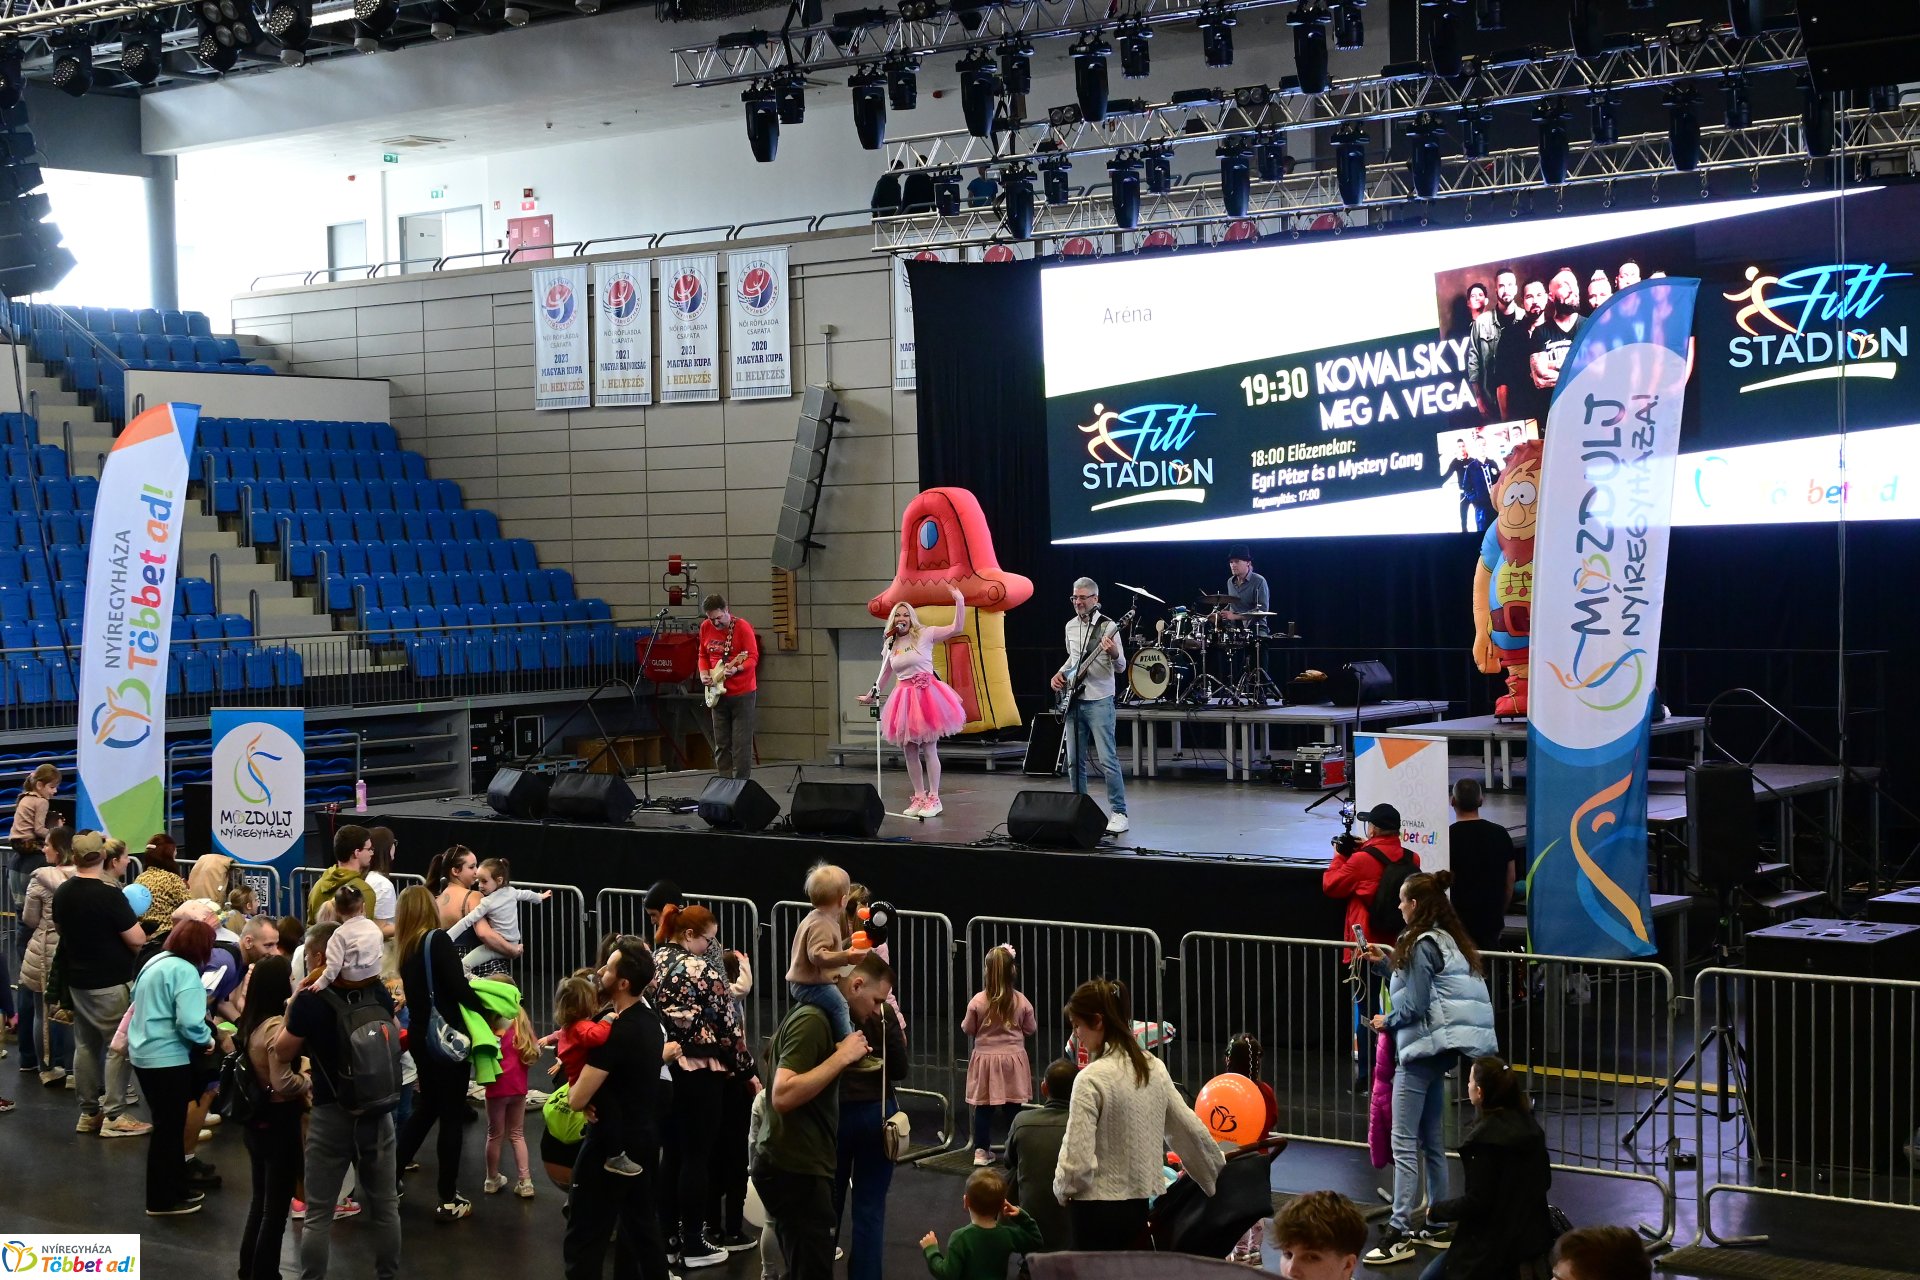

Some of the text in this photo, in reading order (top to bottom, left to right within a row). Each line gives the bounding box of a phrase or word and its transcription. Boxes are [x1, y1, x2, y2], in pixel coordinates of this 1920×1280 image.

[1765, 262, 1914, 341] Fitt
[1103, 305, 1152, 325] Aréna
[681, 345, 696, 356] 2021
[751, 341, 768, 351] 2020
[900, 342, 915, 352] MAGY
[1728, 325, 1908, 368] STADION
[615, 350, 630, 360] 2021
[737, 353, 783, 365] MAGYAR KUPA
[541, 365, 583, 376] MAGYAR KUPA
[600, 361, 620, 372] MAGYAR
[667, 357, 711, 369] MAGYAR KUPA
[1315, 336, 1471, 395] KOWALSKY
[673, 371, 711, 385] HELYEZÉS
[746, 367, 785, 381] HELYEZÉS
[551, 378, 584, 392] HELYEZÉS
[608, 375, 644, 389] HELYEZÉS
[1240, 367, 1308, 406] 19:30
[1319, 378, 1477, 431] MEG A VEGA
[1108, 403, 1217, 468] Fitt
[1251, 438, 1356, 467] 18:00 Előzenekar:
[1082, 457, 1214, 490] STADION
[1252, 452, 1423, 493] Egri Péter és a Mystery Gang
[1299, 488, 1320, 501] 17:00
[140, 483, 174, 544] ad!
[1571, 392, 1626, 637] MOZDULJ
[1613, 394, 1660, 637] NYÍREGYHÁZA!
[102, 529, 131, 669] NYÍREGYHÁZA
[128, 549, 168, 671] Többet
[652, 659, 673, 667] GLOBUS
[220, 809, 293, 826] MOZDULJ
[220, 825, 293, 839] NYÍREGYHÁZA!
[1422, 831, 1438, 845] ad!
